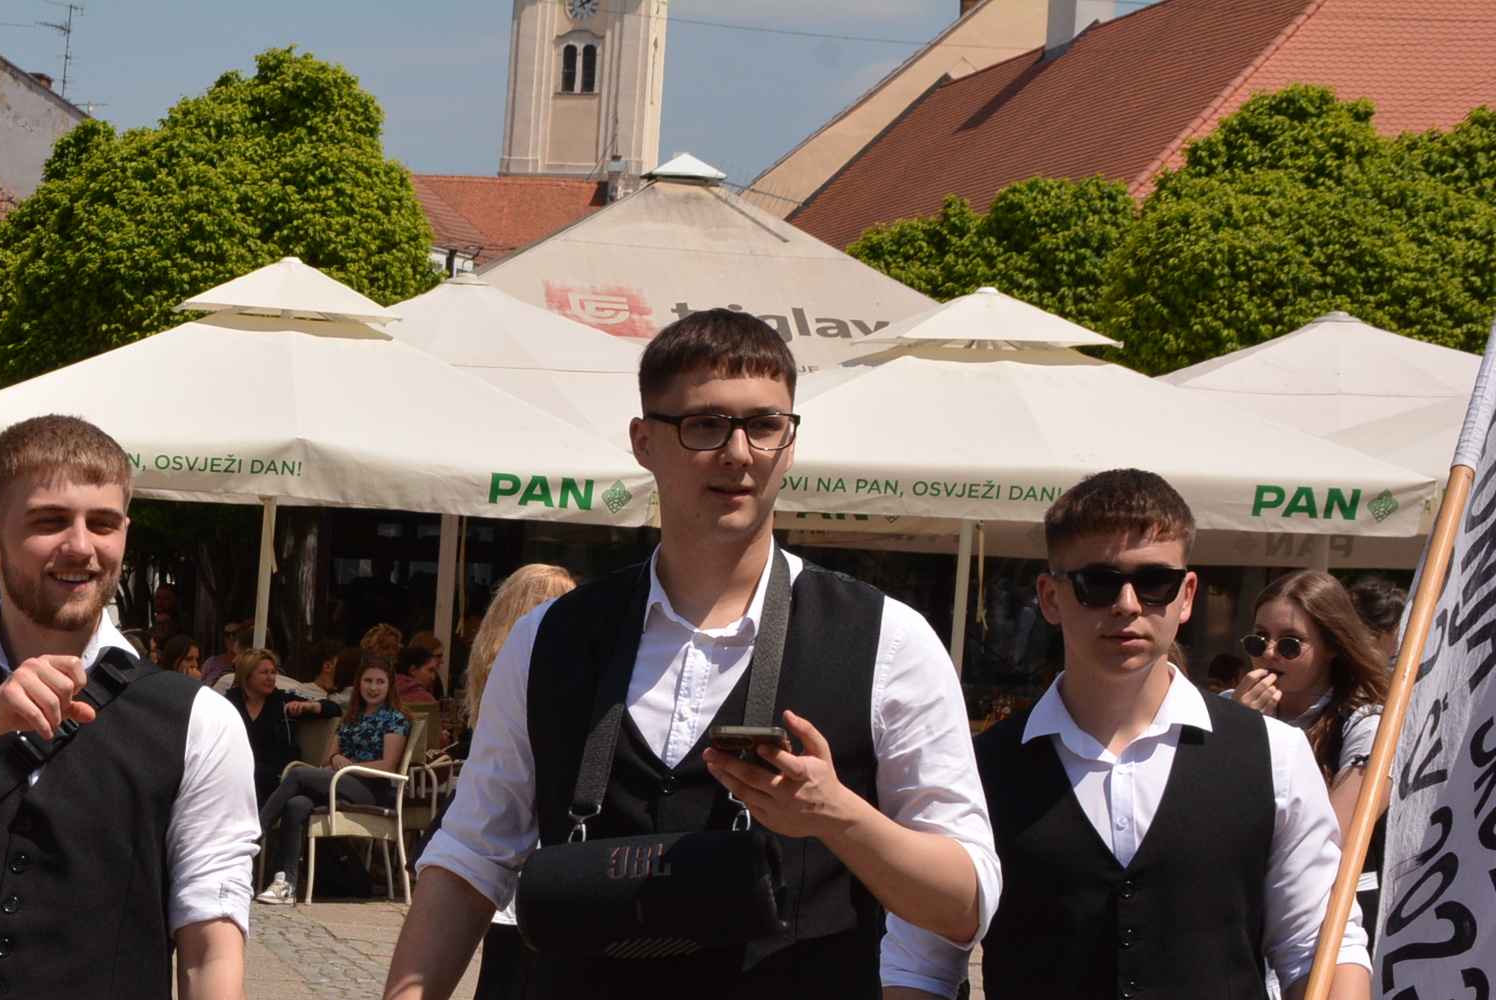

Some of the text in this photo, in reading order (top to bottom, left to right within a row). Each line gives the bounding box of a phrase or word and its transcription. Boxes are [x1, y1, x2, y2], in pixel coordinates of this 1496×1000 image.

[154, 454, 242, 474] OSVJEŽI
[250, 459, 303, 477] DAN!
[488, 472, 595, 511] PAN
[816, 477, 847, 493] NA
[856, 478, 903, 498] PAN,
[912, 480, 1001, 500] OSVJEŽI
[1251, 484, 1362, 520] PAN
